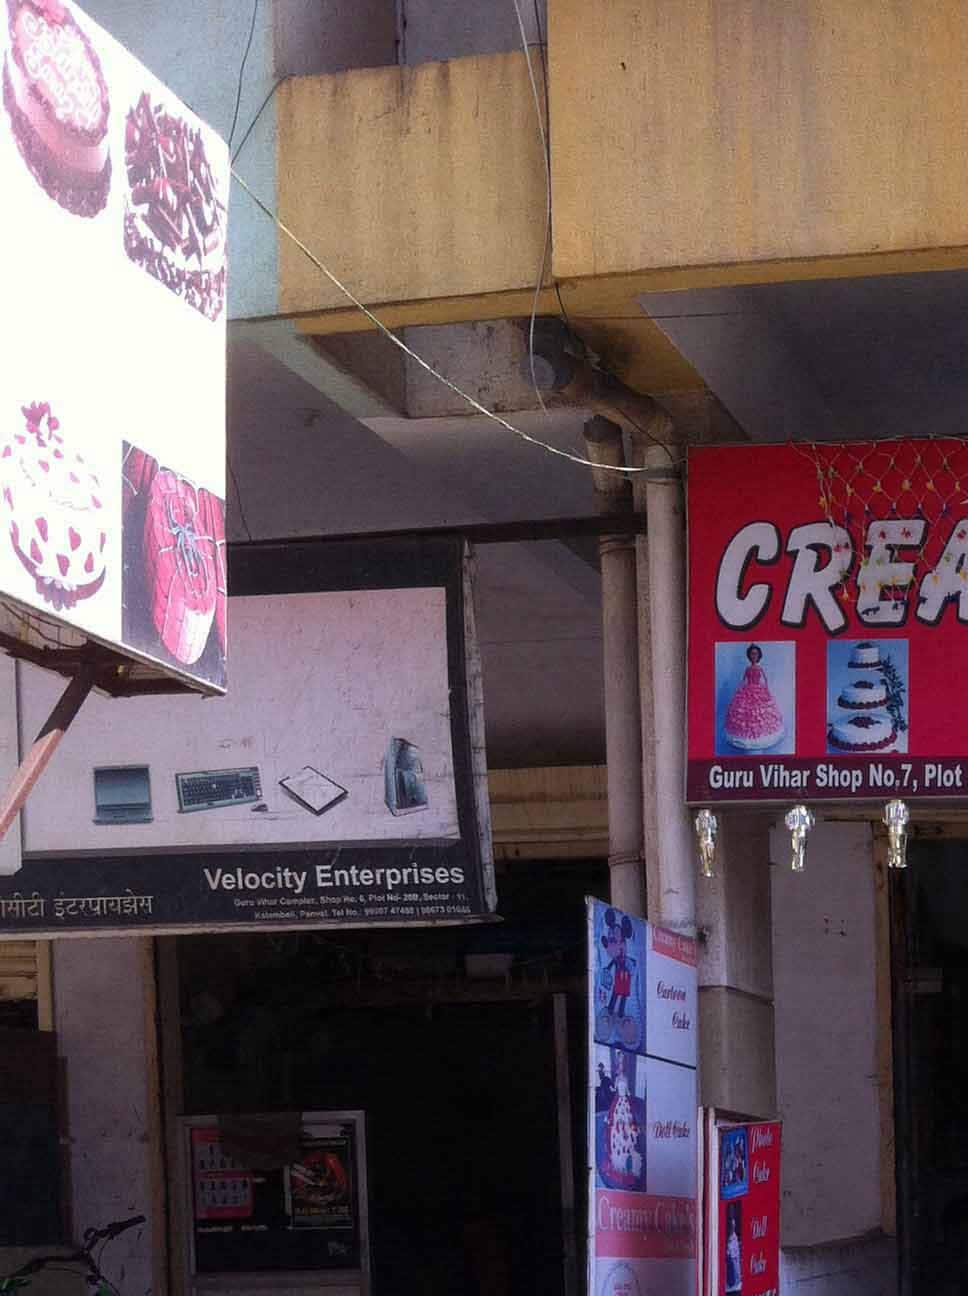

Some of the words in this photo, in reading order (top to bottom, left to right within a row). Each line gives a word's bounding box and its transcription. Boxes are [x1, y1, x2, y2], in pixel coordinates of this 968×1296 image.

[709, 766, 753, 789] Guru
[760, 765, 811, 788] Vihar
[815, 764, 863, 792] Shop
[869, 763, 918, 792] No.7,
[924, 763, 963, 787] Plot
[205, 866, 307, 893] Velocity
[316, 863, 465, 889] Enterprises
